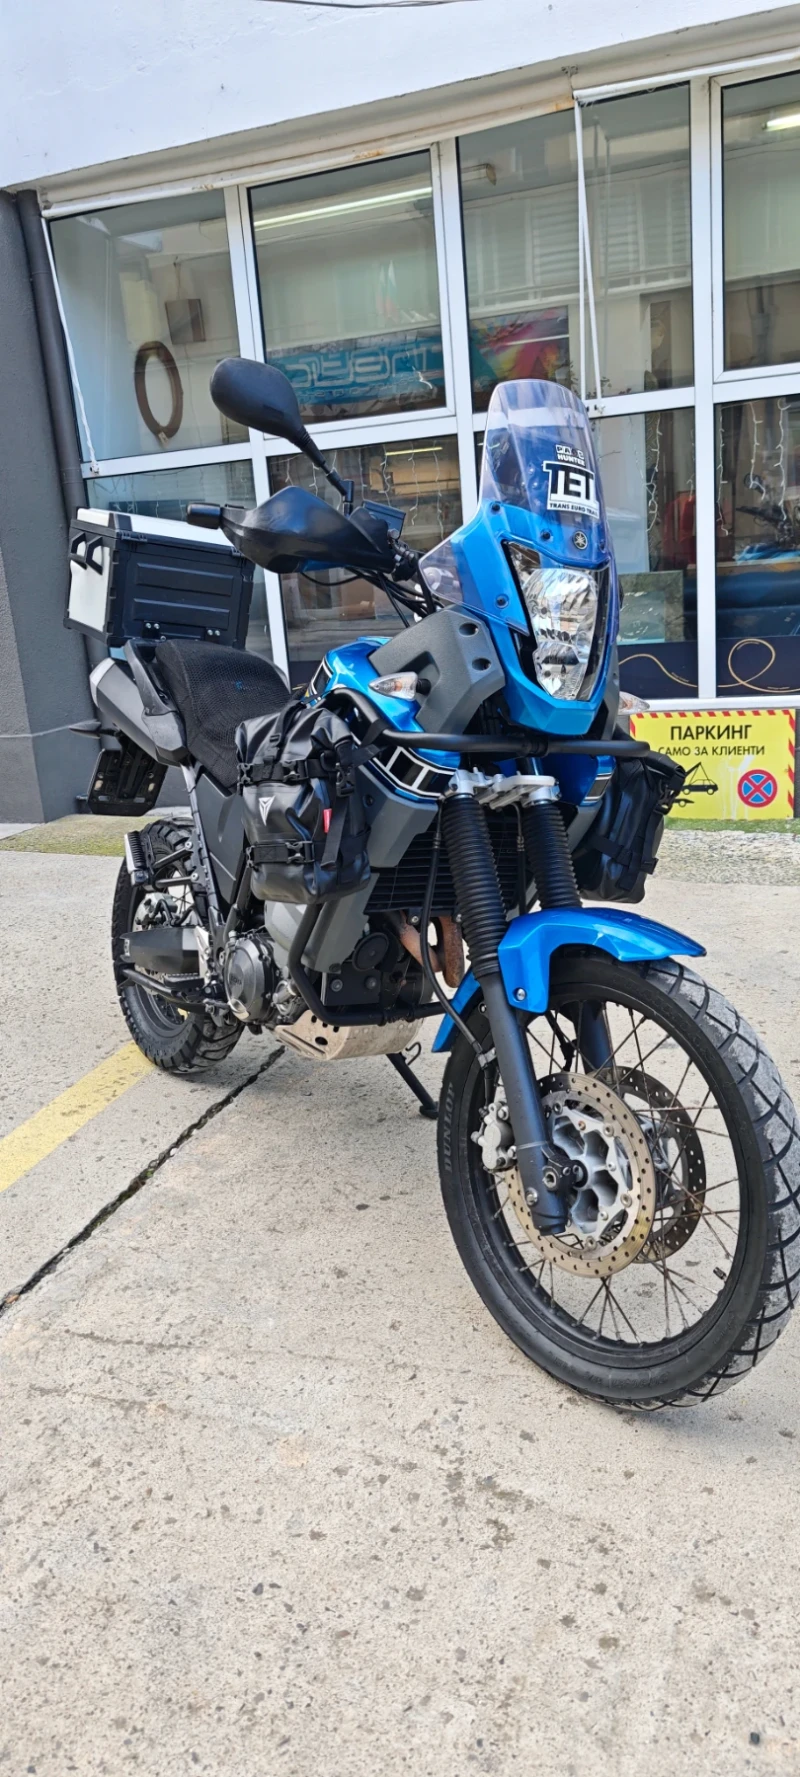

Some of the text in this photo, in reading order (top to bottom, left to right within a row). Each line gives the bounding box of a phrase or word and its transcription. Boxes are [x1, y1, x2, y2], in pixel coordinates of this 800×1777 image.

[557, 453, 586, 467] HUNTER
[545, 462, 594, 501] TET
[549, 502, 570, 510] TRANS
[571, 504, 586, 513] EURO
[670, 724, 752, 741] ПАРКИНГ
[658, 745, 765, 756] САМО ЗА КЛИЕНТИ
[443, 1082, 455, 1173] DUNLOP
